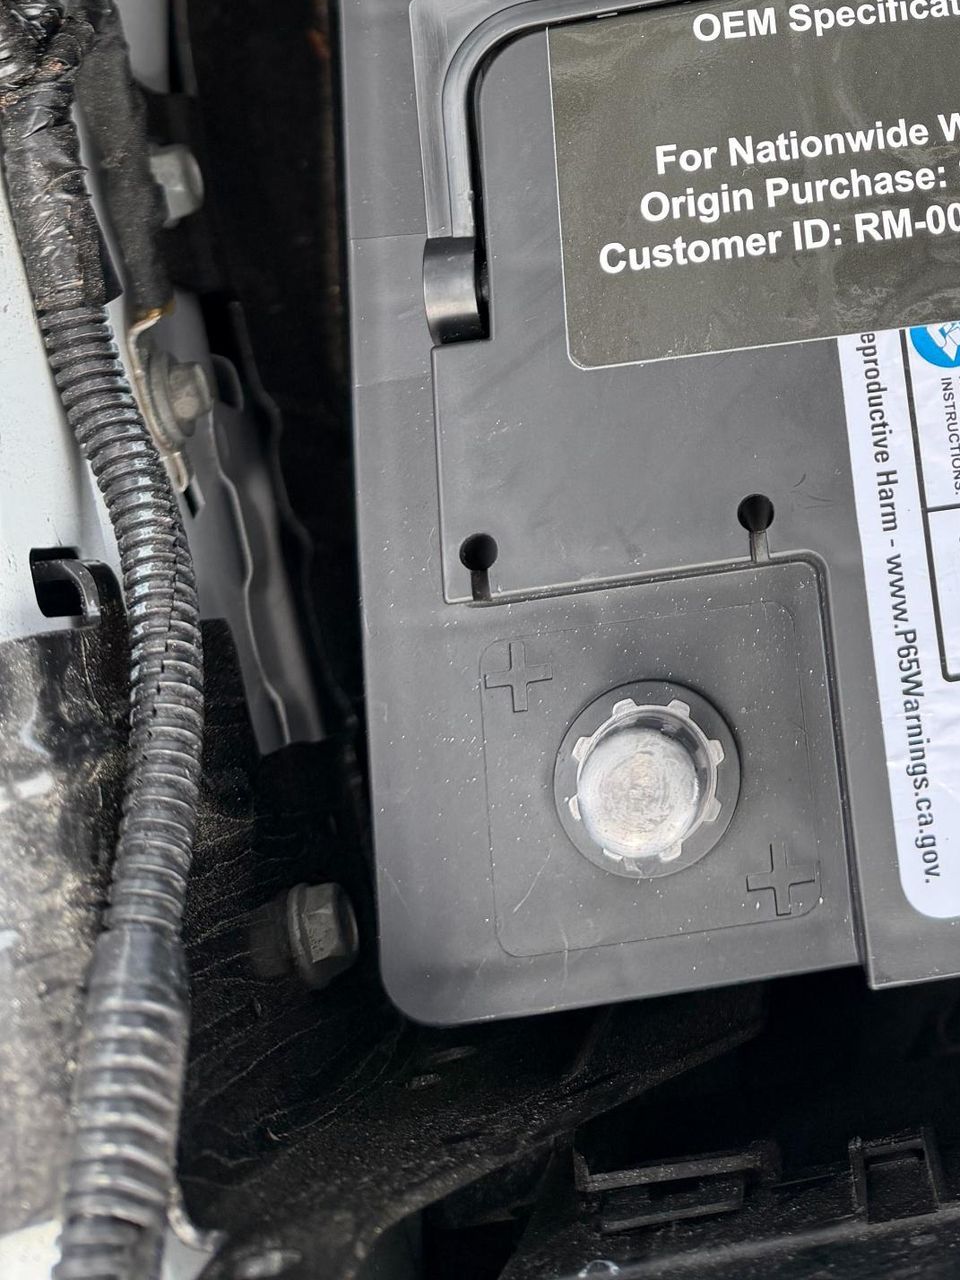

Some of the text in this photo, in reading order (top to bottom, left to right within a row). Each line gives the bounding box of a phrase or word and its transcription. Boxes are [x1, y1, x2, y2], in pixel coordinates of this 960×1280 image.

[692, 7, 778, 42] OEM
[656, 143, 719, 175] For
[730, 123, 928, 168] Nationwide
[640, 187, 755, 224] Origin
[766, 164, 947, 210] Purchase:
[599, 231, 782, 275] Customer
[794, 221, 843, 254] ID:
[856, 332, 893, 463] eproductive
[876, 470, 899, 532] Harm
[886, 553, 941, 884] www.P65Warnings.ca.gov.
